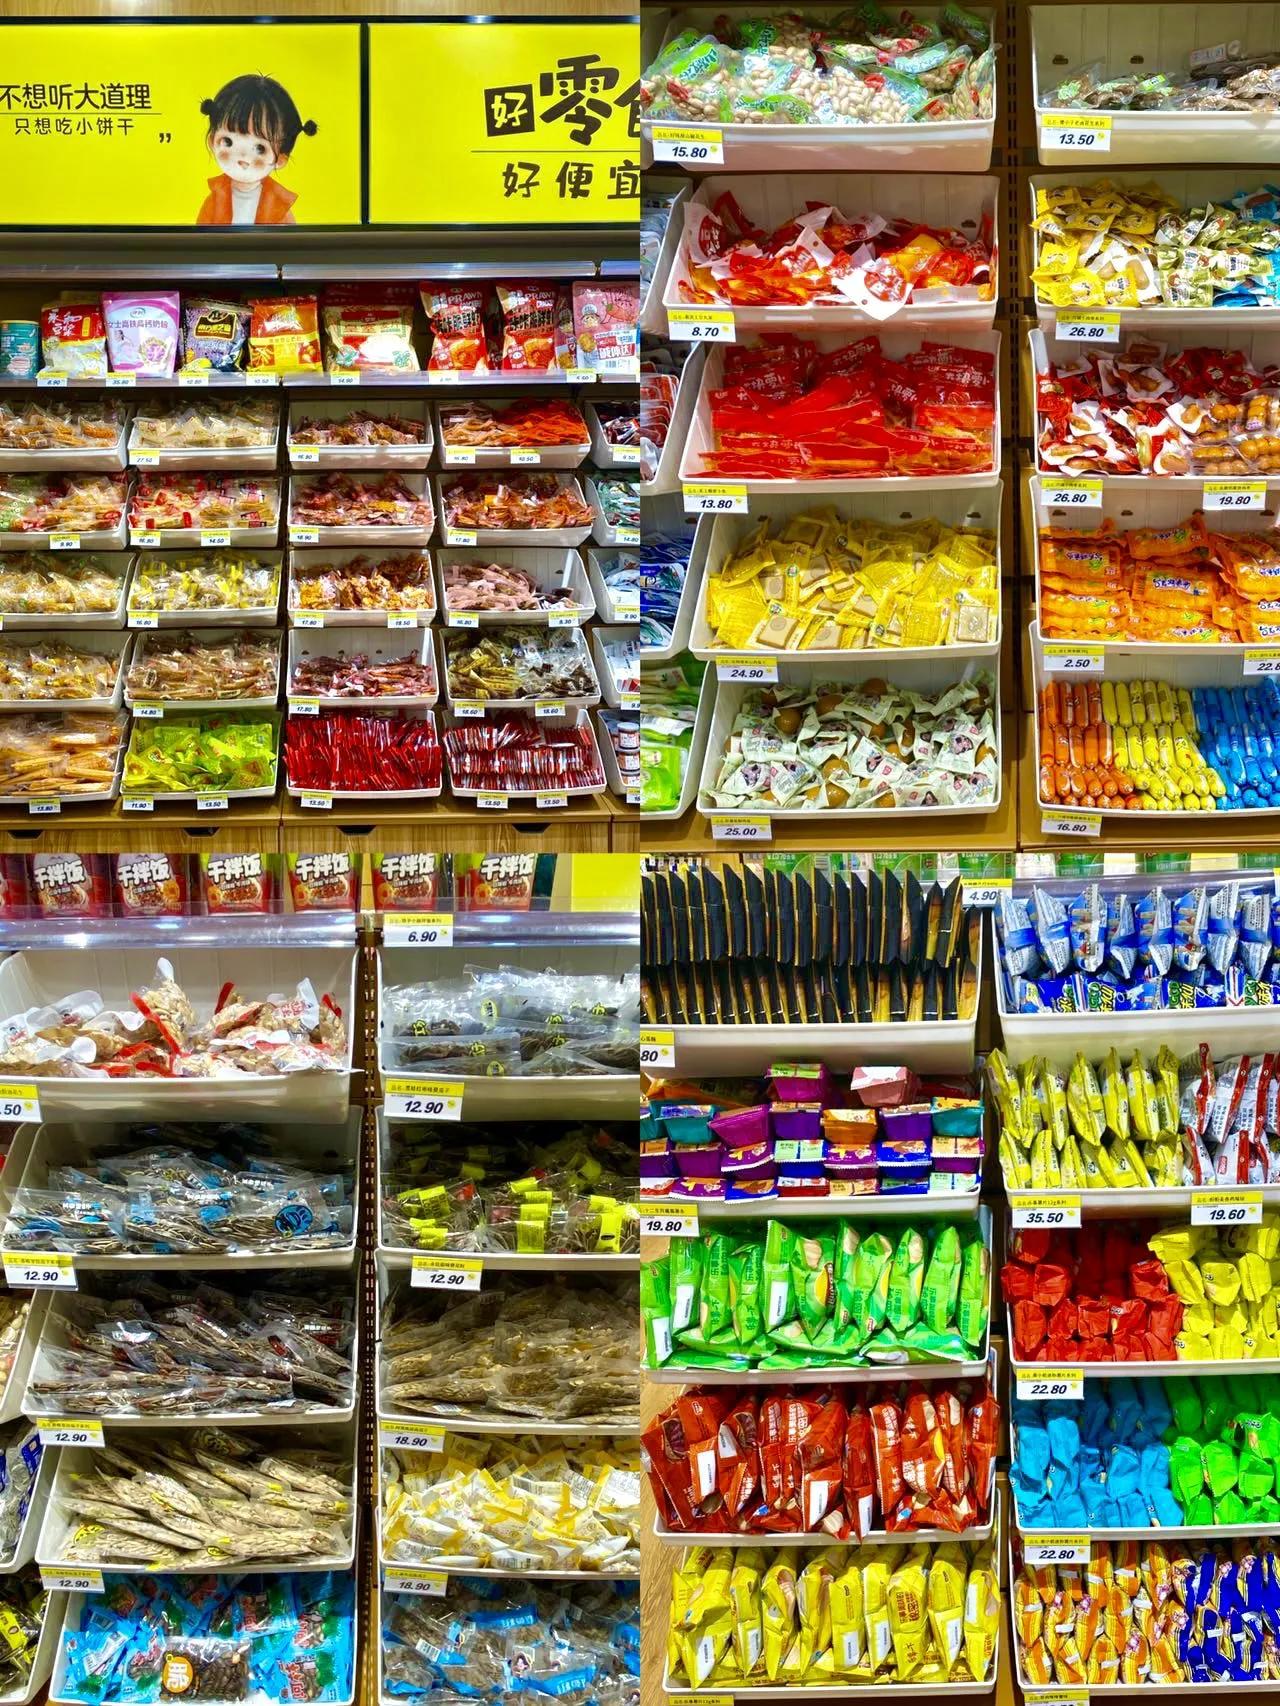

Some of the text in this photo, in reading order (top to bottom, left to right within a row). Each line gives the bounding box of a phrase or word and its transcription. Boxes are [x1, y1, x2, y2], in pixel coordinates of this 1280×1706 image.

[0, 82, 152, 111] 不想听大道理
[14, 117, 136, 137] 只想吃小饼干
[1059, 134, 1094, 145] 13.50
[672, 147, 707, 157] 15.80
[692, 327, 719, 336] 8.70
[1069, 328, 1104, 337] 26.80
[1054, 494, 1087, 502] 26.80
[700, 500, 732, 508] 13.80
[117, 857, 171, 886] 干拌饭
[207, 853, 262, 884] 干拌饭
[295, 853, 350, 882] 干拌饭
[381, 853, 435, 880] 干拌饭
[480, 853, 535, 881] 干拌饭
[34, 863, 86, 888] 干拌饭
[970, 892, 996, 900] 4.90
[408, 932, 437, 941] 6.90
[405, 1101, 443, 1113] 12.90
[1027, 1213, 1063, 1223] 35.50
[1210, 1210, 1245, 1220] 19.60
[647, 1221, 682, 1231] 19.80
[24, 1272, 58, 1280] 12.90
[430, 1274, 464, 1284] 12.90
[1031, 1385, 1066, 1394] 22.80
[55, 1433, 87, 1442] 12.90
[395, 1436, 427, 1446] 18.90
[1039, 1550, 1074, 1559] 22.80
[59, 1580, 88, 1588] 12.90
[399, 1582, 430, 1590] 18.90
